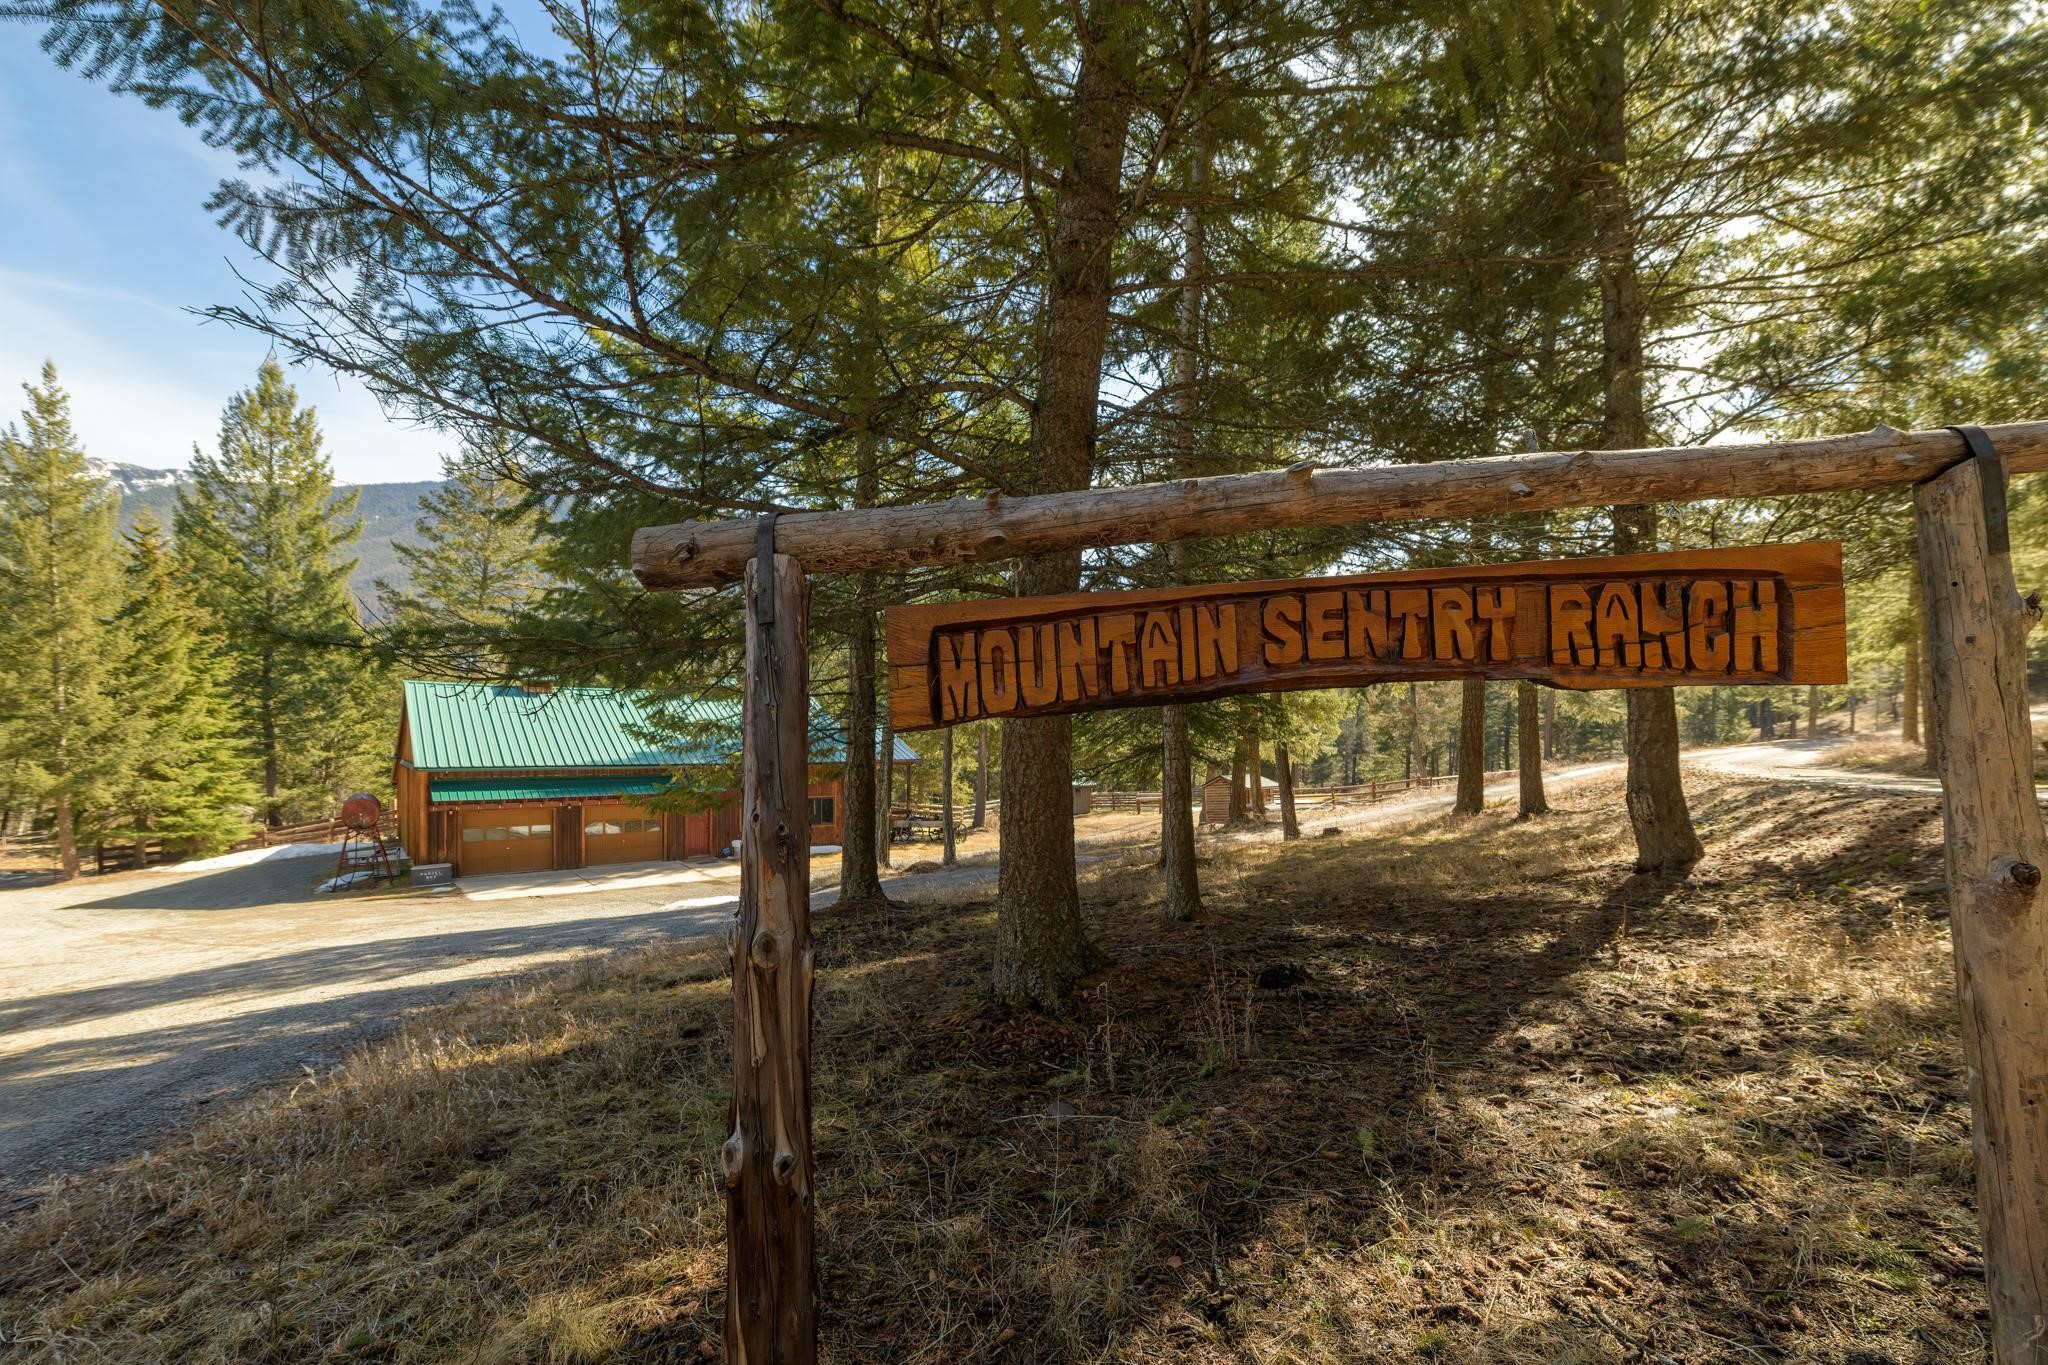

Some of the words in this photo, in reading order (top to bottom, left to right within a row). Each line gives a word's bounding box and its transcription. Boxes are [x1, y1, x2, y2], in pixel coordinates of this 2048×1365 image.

[939, 603, 1239, 721] MOUNTAIN
[1263, 586, 1517, 664] SENTRY
[1550, 579, 1779, 672] RANCH
